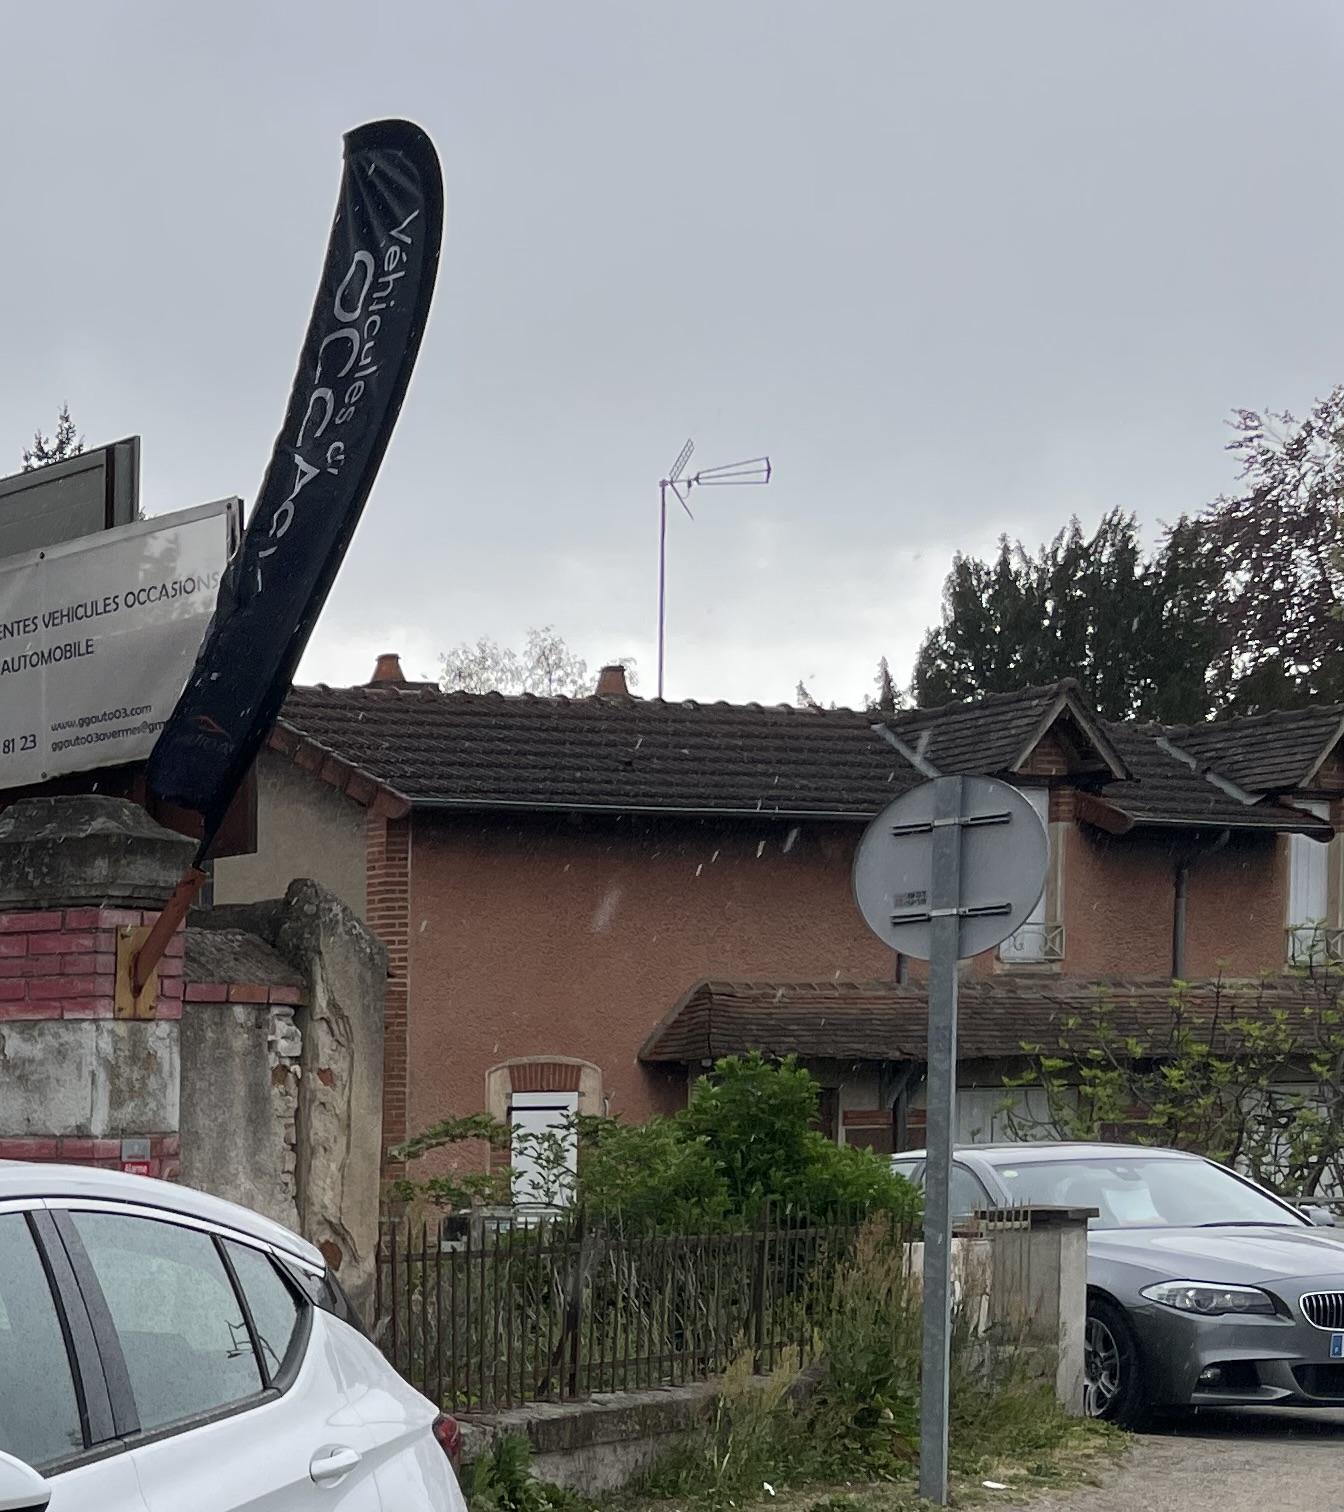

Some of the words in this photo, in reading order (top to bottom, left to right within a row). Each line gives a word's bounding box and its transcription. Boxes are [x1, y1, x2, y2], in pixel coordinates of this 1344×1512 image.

[335, 209, 419, 424] Véhicules
[42, 595, 119, 629] VEHICULES
[124, 571, 220, 608] OCCASIONS
[1, 638, 94, 676] AUTOMOBILE
[3, 738, 15, 754] 81
[20, 734, 37, 751] 23
